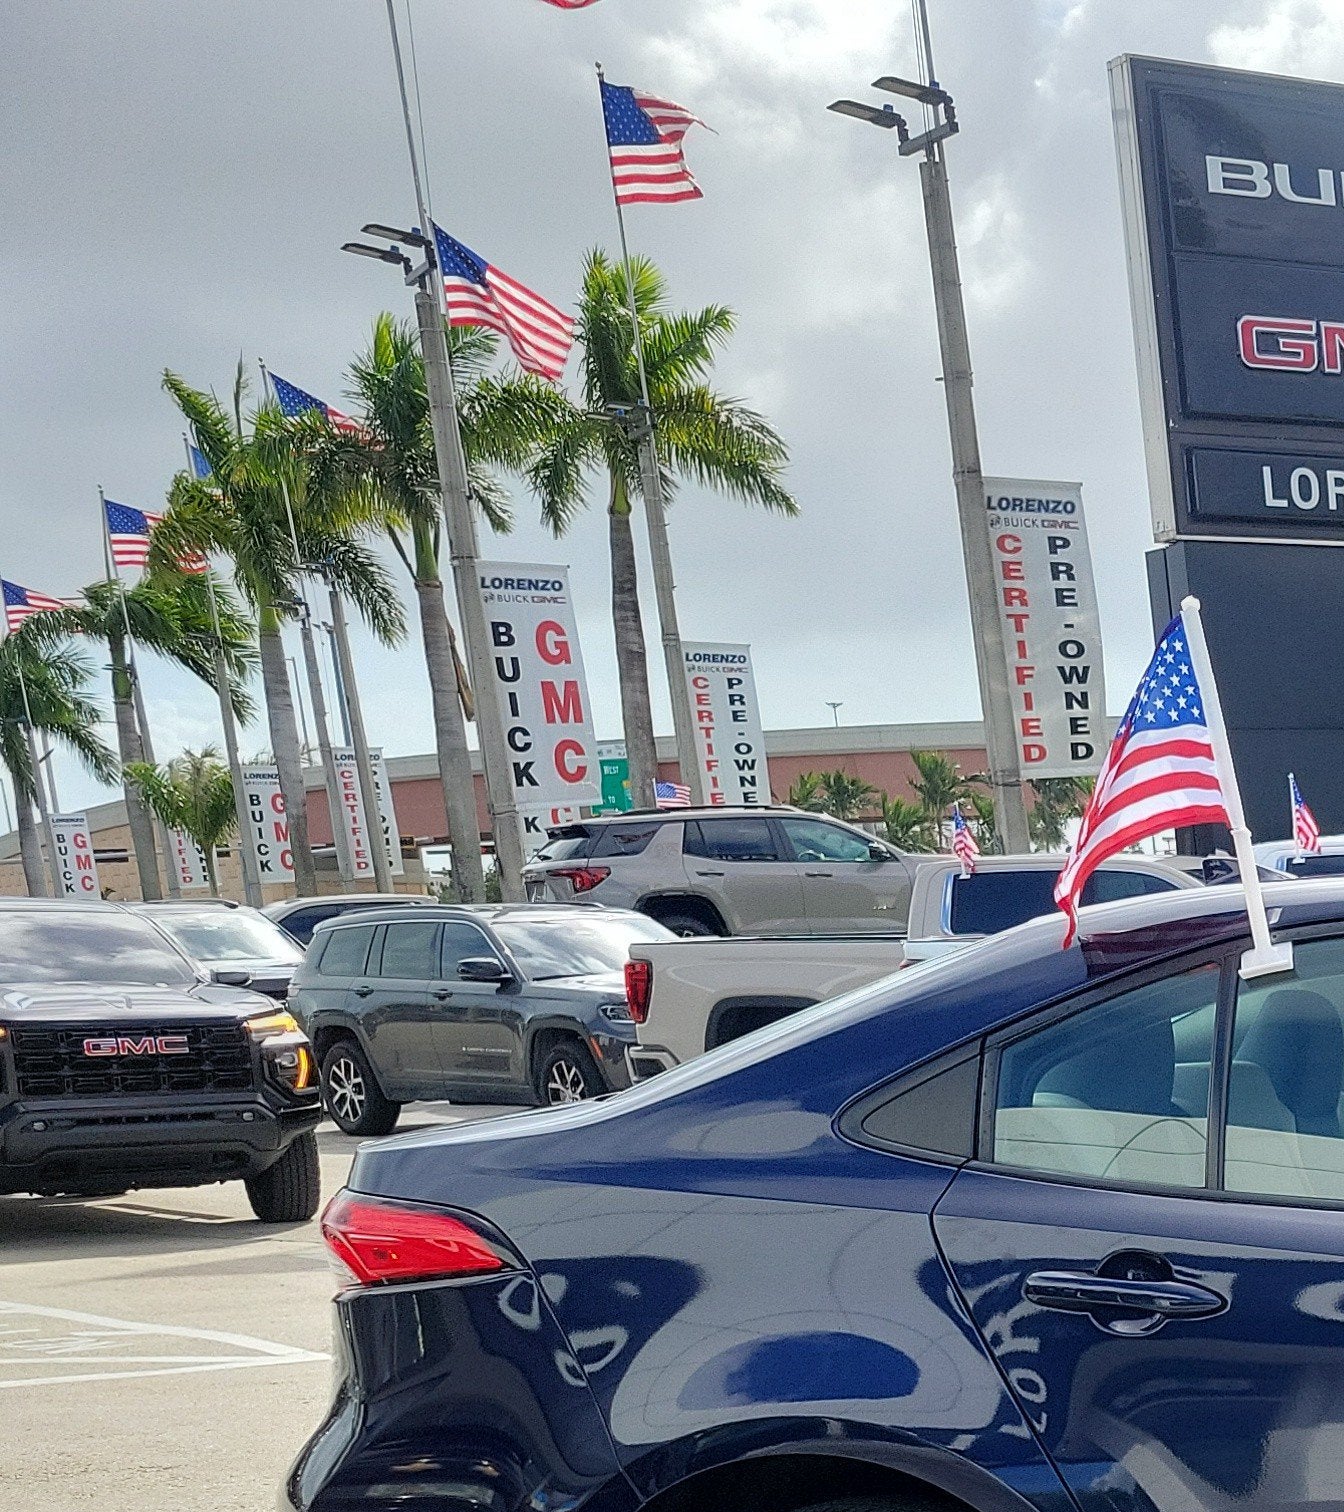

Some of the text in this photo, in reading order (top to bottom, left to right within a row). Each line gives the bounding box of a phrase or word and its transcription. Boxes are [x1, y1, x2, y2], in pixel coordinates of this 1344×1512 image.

[987, 496, 1075, 514] LORENZO
[1004, 518, 1079, 530] BUICK GMC
[481, 576, 563, 592] LORENZO
[497, 595, 566, 604] BUICK GMC
[685, 652, 747, 664] LORENZO
[996, 534, 1047, 763] CERTIFIED
[1047, 536, 1094, 761] PRE-OWNED
[490, 621, 540, 787] BUICK
[535, 620, 588, 784] GMC
[692, 676, 726, 805] CERTIFIE
[726, 677, 758, 804] PRE-OWNE
[249, 794, 273, 873] BUICK
[340, 770, 369, 870] CERTIFIED
[56, 834, 76, 893] BUICK
[73, 833, 94, 892] GMC
[83, 1036, 189, 1056] GMC
